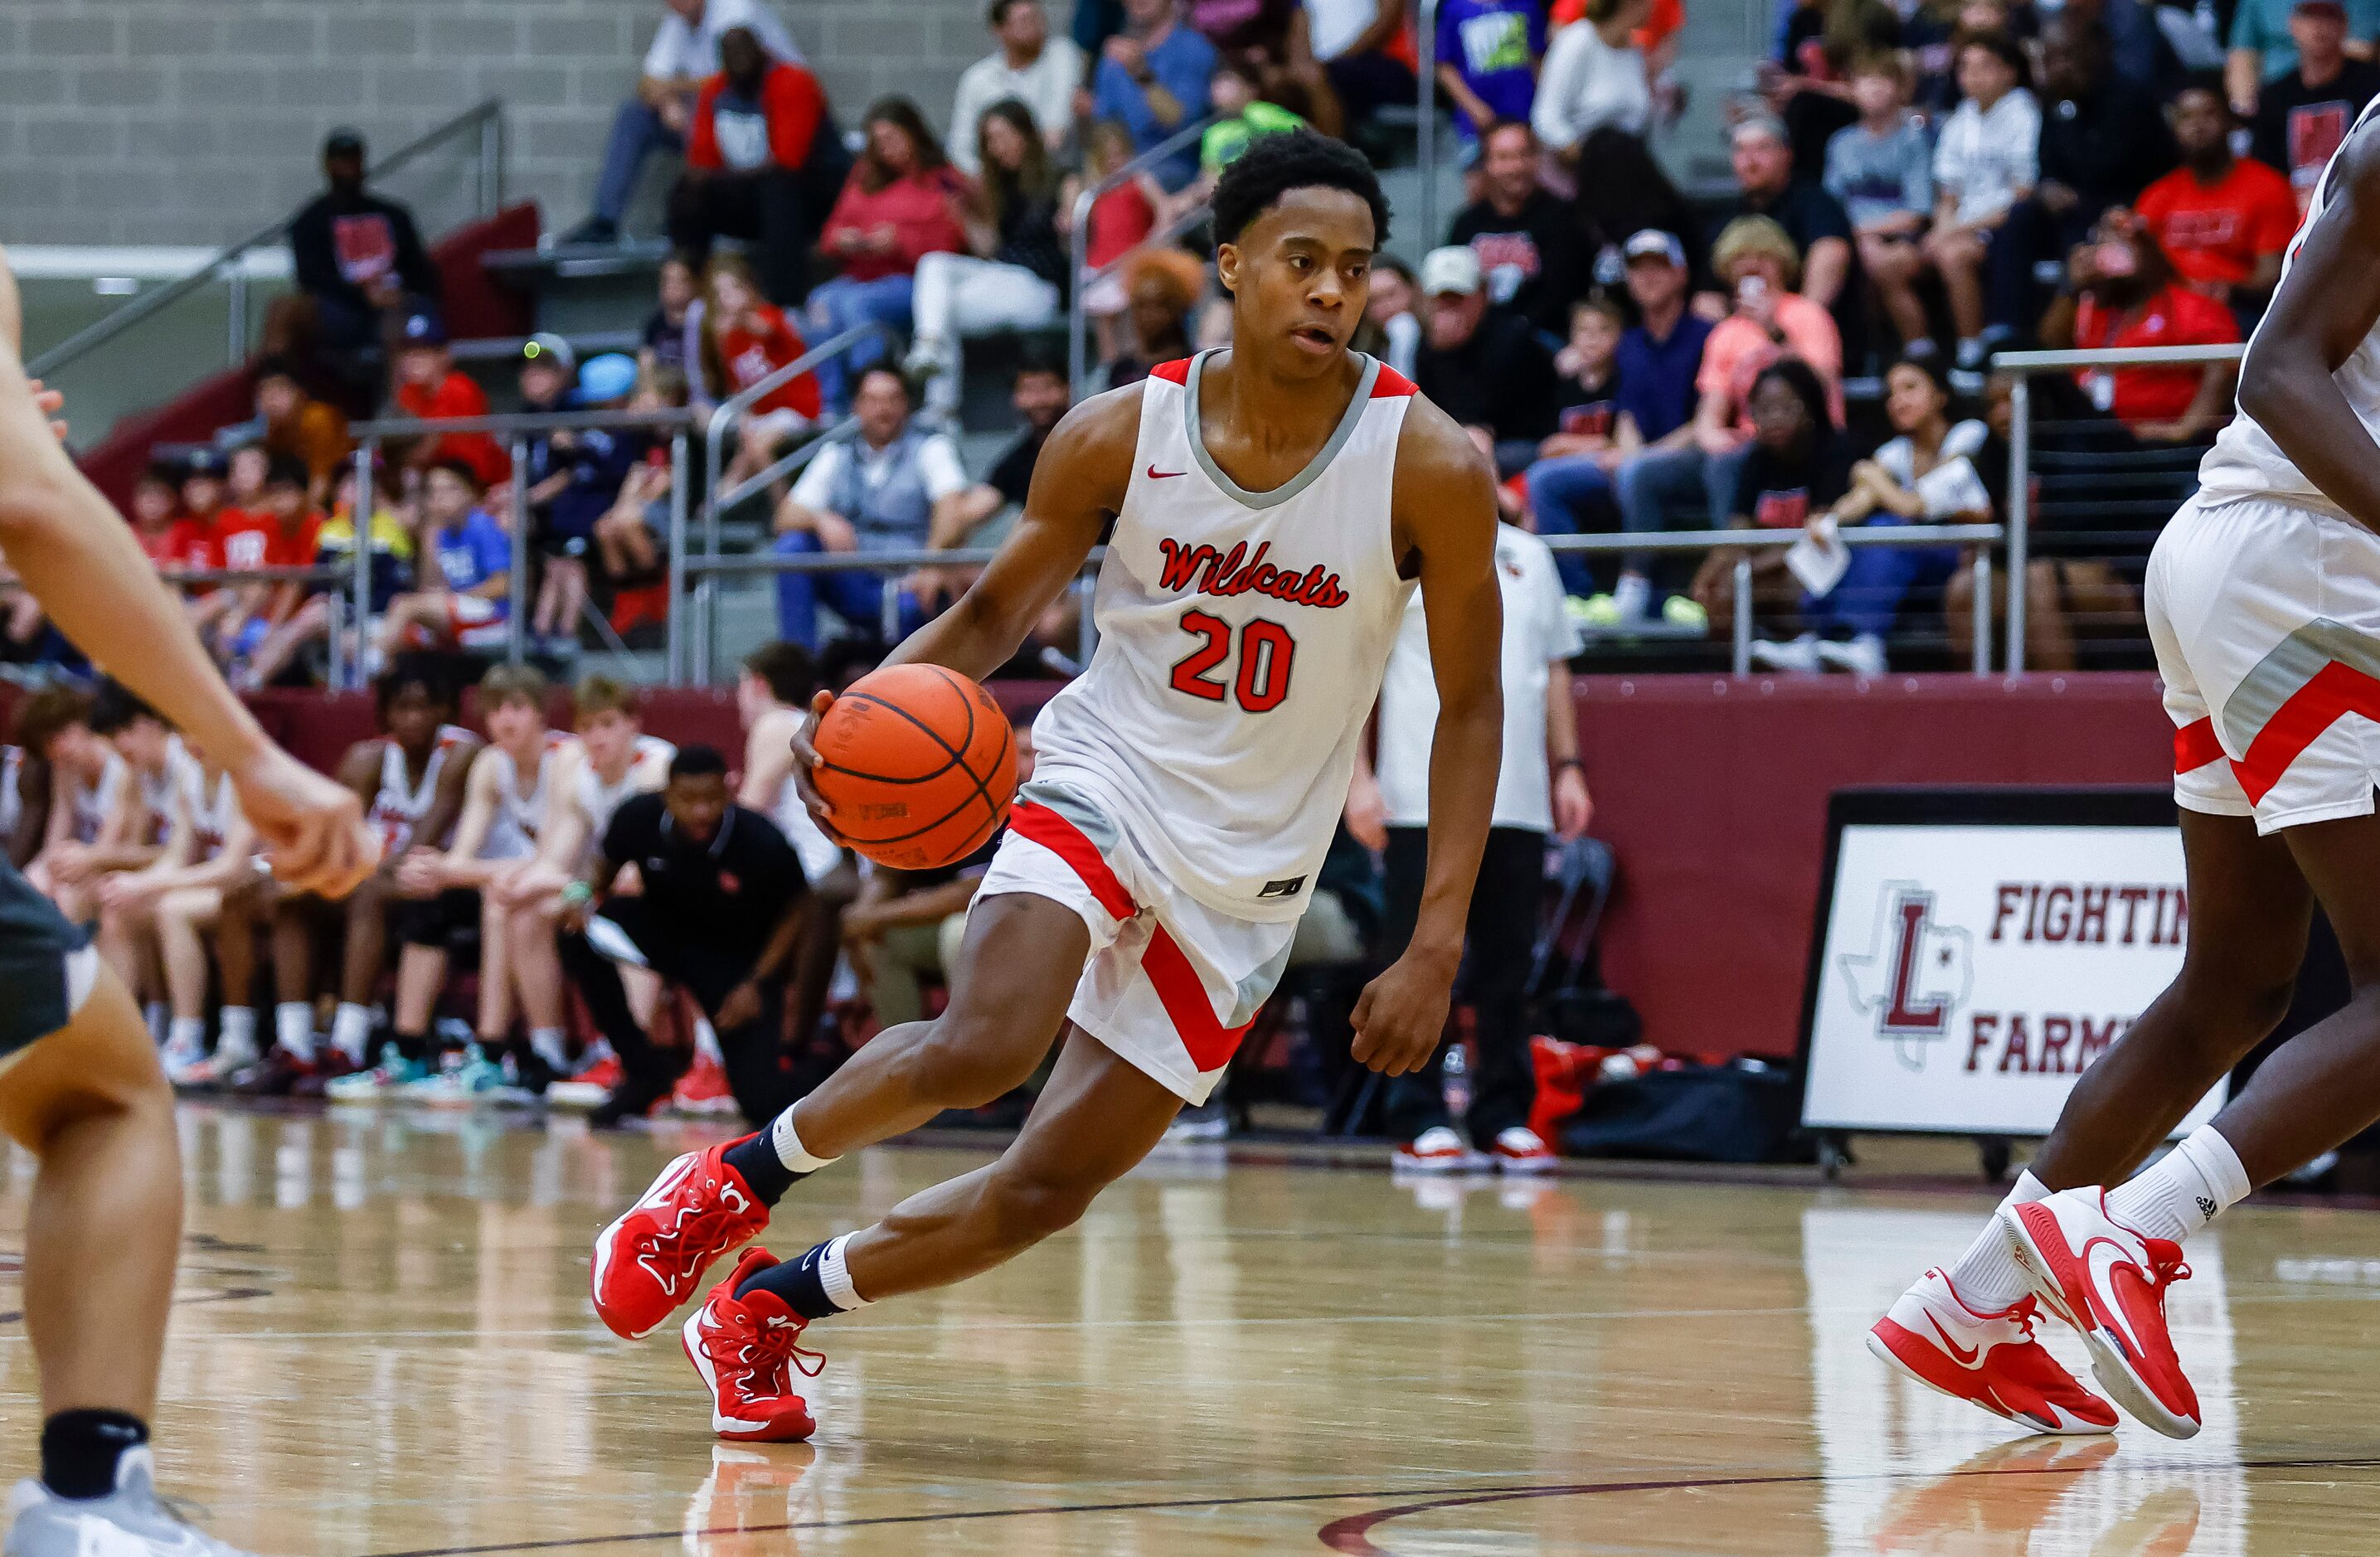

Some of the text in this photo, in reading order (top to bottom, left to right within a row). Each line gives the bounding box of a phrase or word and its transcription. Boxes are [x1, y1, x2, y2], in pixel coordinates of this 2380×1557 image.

[1158, 537, 1350, 609] Wildcats
[1168, 606, 1299, 715] 20
[1881, 897, 1949, 1035] L
[1965, 1013, 2136, 1075] FARM
